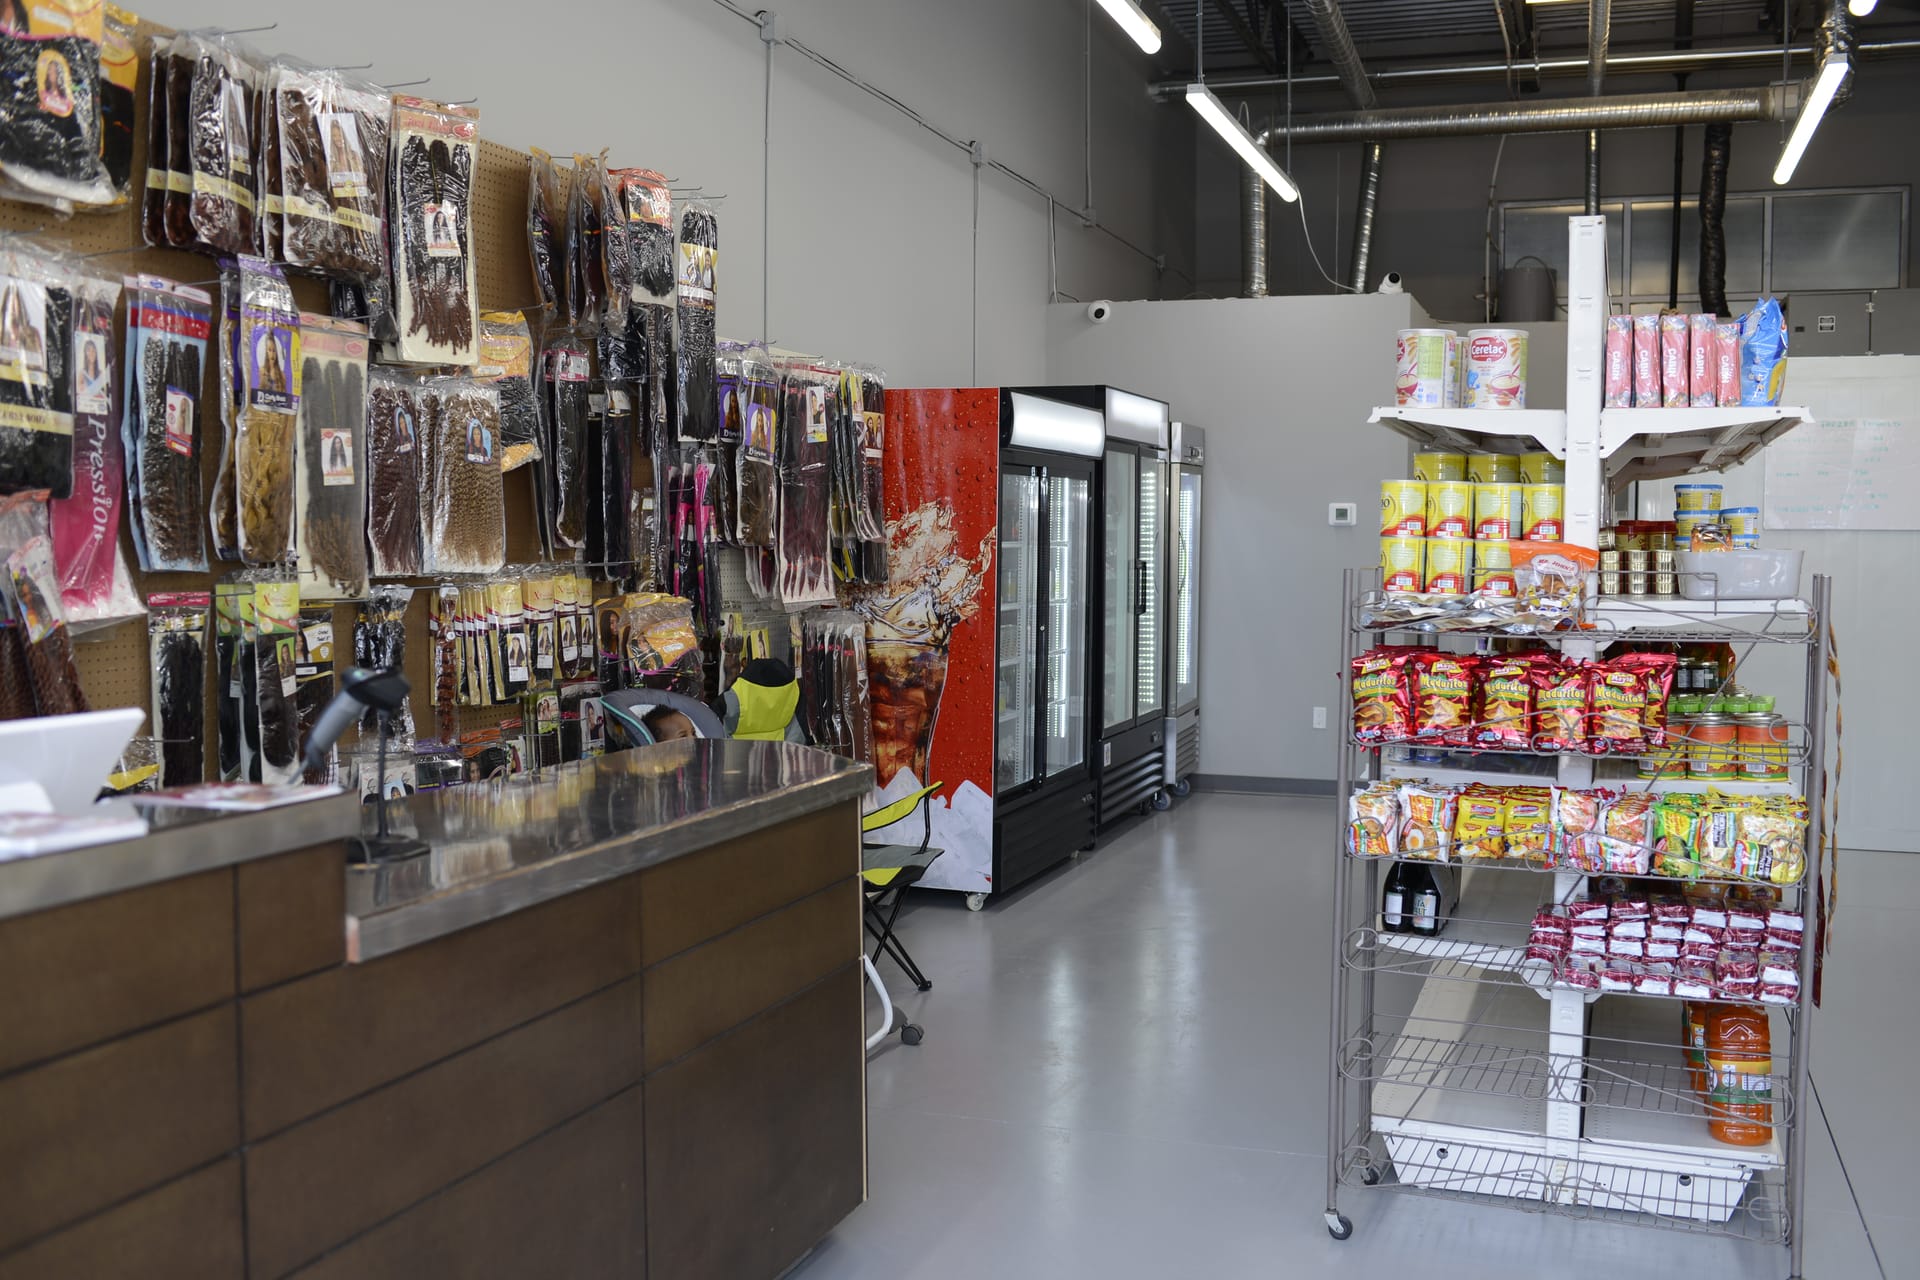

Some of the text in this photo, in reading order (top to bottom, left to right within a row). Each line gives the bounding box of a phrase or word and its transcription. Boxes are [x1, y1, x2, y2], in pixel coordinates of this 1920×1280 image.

[1471, 344, 1504, 355] Cerelac
[1611, 350, 1620, 381] CABIN
[1640, 349, 1649, 380] CABIN
[1667, 348, 1677, 379] CABIN
[1720, 354, 1729, 385] CABIN
[1353, 673, 1397, 691] Maduritos
[1419, 674, 1468, 689] Maduritos
[1485, 679, 1529, 694] Maduritos
[1594, 686, 1644, 703] Maduritos
